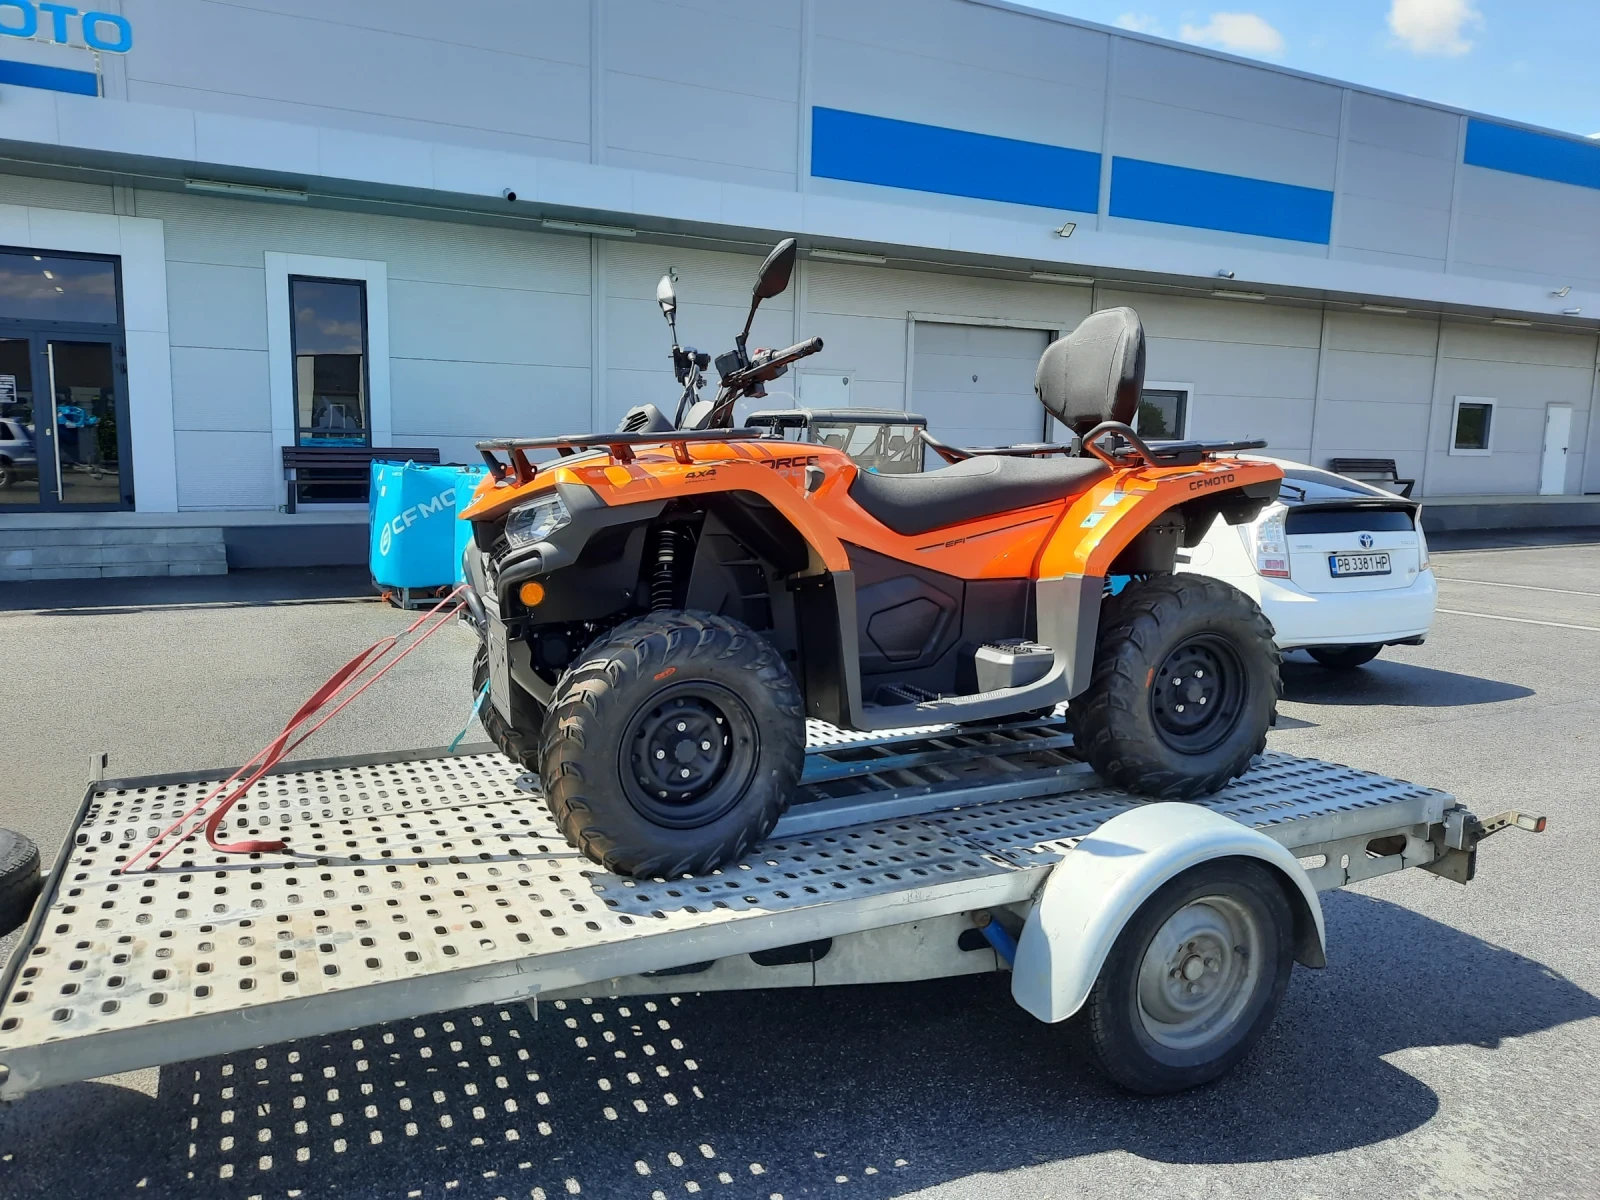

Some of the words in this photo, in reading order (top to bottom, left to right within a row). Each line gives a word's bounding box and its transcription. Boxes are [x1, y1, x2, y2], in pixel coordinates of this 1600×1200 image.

[0, 0, 133, 53] OTO
[1189, 473, 1235, 491] CFMOTO
[944, 537, 966, 548] EFI
[1337, 558, 1351, 571] PB
[1352, 556, 1374, 571] 3381
[1375, 556, 1388, 569] HP
